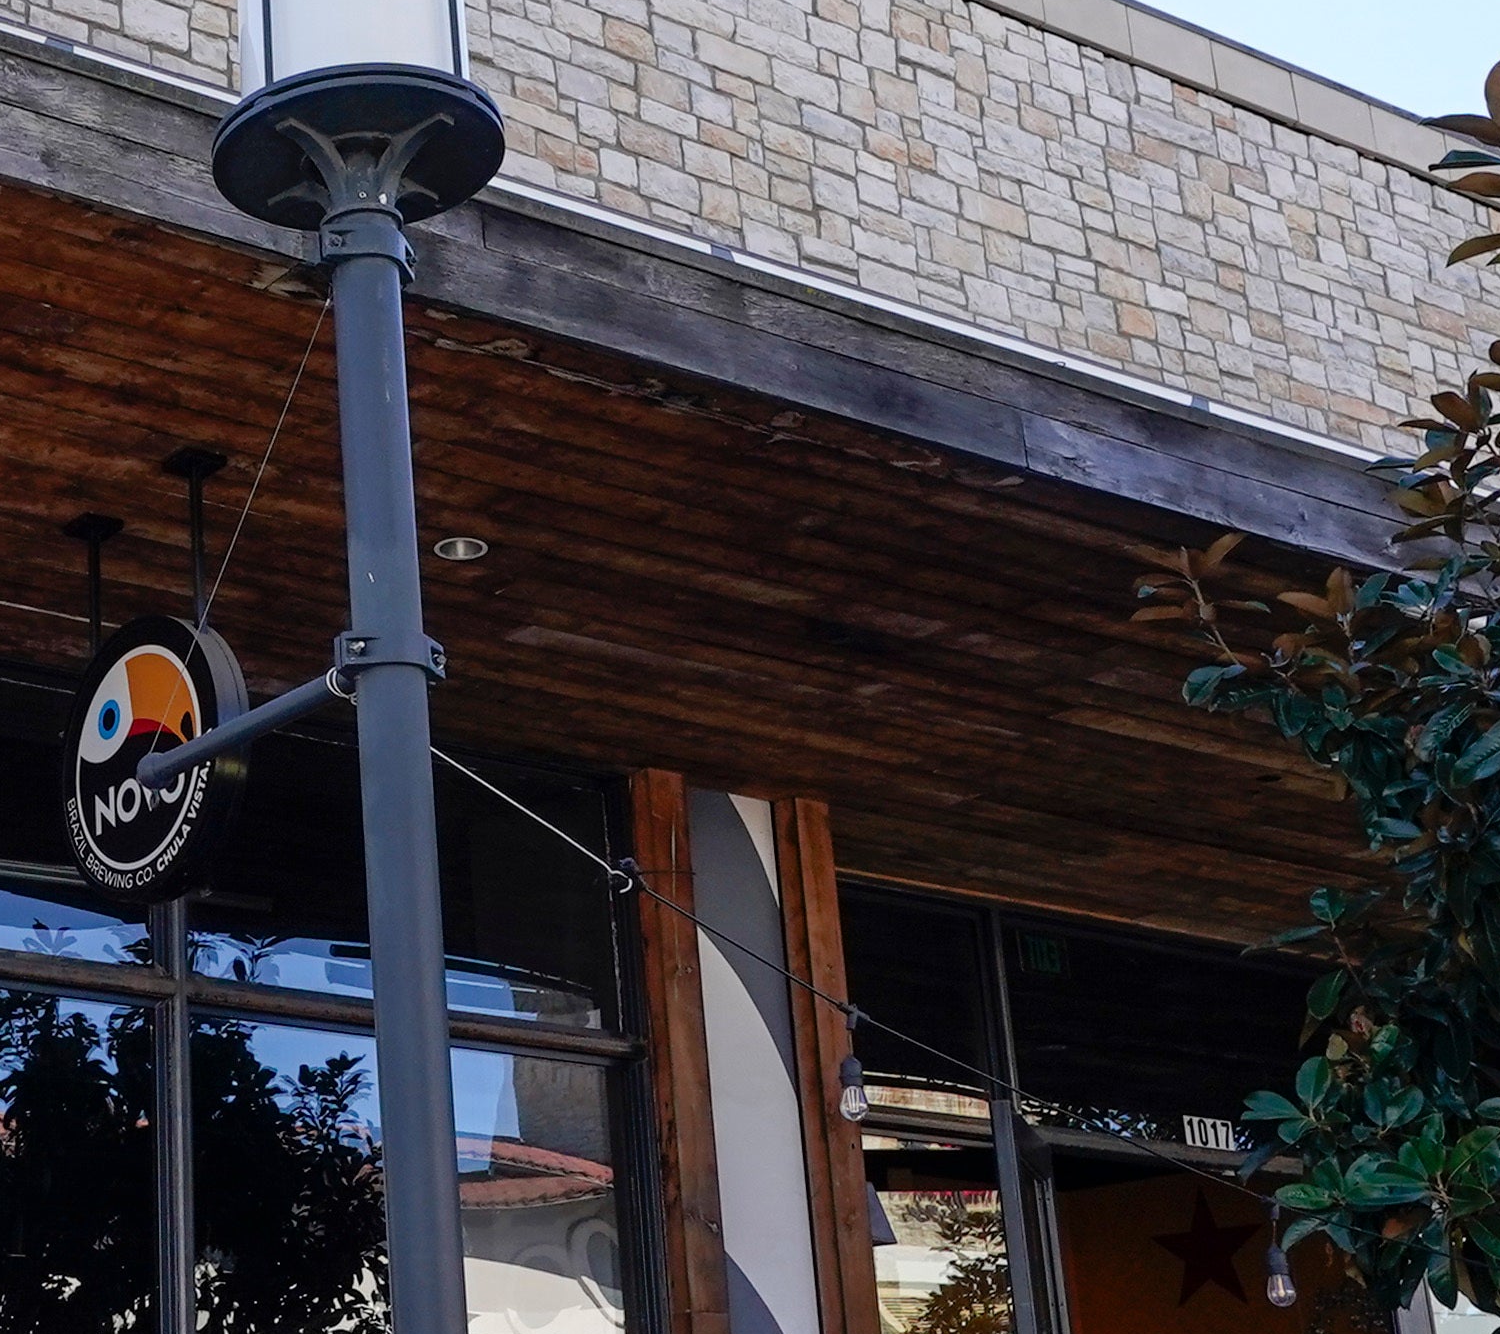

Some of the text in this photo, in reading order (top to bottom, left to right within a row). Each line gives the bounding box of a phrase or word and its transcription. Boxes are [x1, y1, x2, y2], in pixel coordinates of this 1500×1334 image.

[67, 798, 86, 858] BRAZIL
[86, 853, 133, 889] BREWING
[135, 869, 156, 886] CO.
[156, 825, 192, 872] CHULA
[1187, 1118, 1230, 1149] 1017
